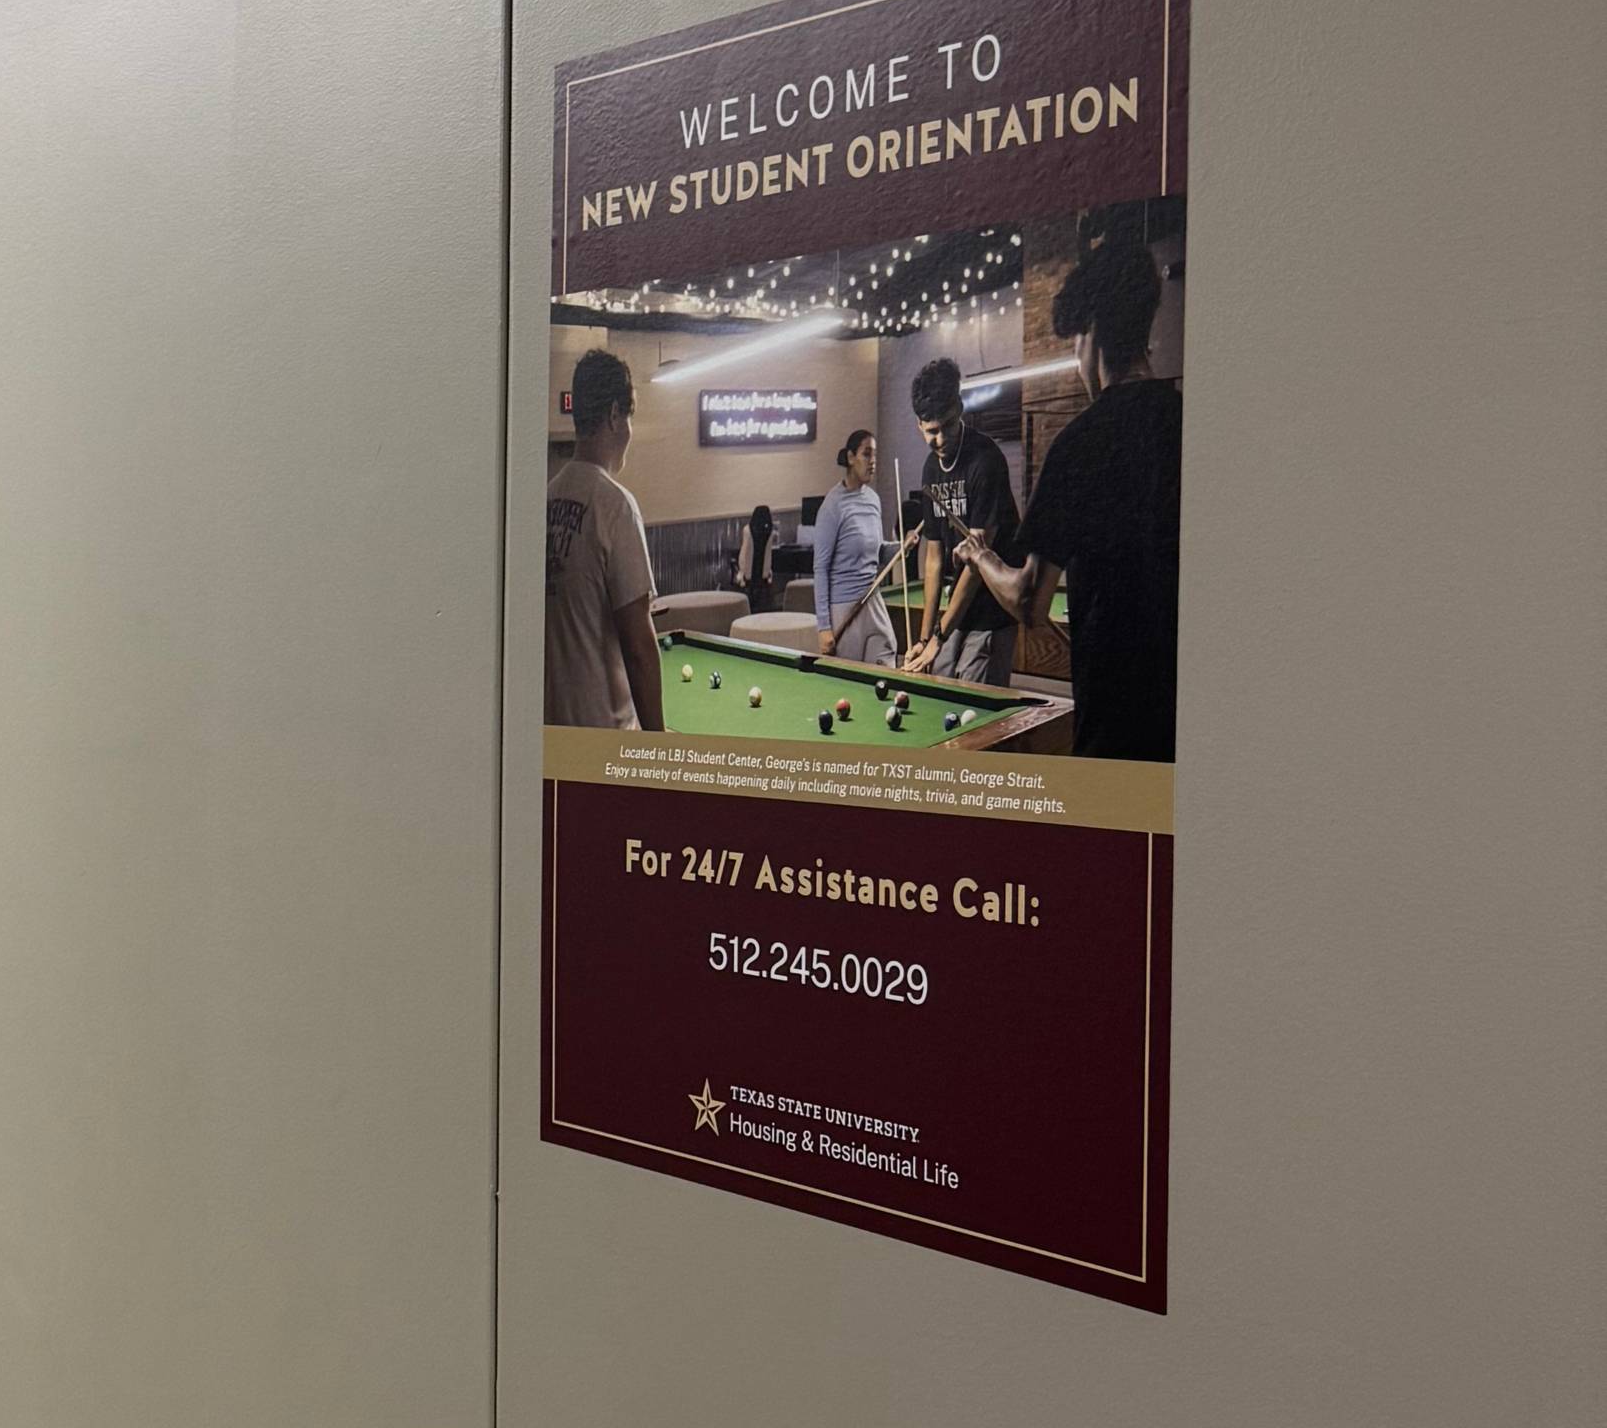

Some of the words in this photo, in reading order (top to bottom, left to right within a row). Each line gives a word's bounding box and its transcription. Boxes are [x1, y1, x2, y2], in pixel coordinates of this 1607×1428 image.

[680, 55, 910, 149] WELCOME
[938, 34, 1002, 90] TO
[582, 180, 659, 232] NEW
[669, 143, 834, 214] STUDENT
[846, 77, 1139, 179] ORIENTATION
[605, 762, 630, 779] Enjoy
[631, 767, 637, 777] a
[638, 765, 670, 782] variety
[671, 768, 682, 781] of
[683, 771, 715, 784] events
[716, 771, 768, 791] happening
[771, 775, 796, 793] daily
[797, 777, 847, 798] including
[849, 784, 882, 798] movie
[884, 785, 923, 803] nights,
[925, 789, 958, 806] trivia,
[961, 791, 984, 807] and
[986, 796, 1021, 811] game
[1023, 796, 1066, 814] nights.
[620, 745, 656, 761] Located
[657, 748, 667, 761] in
[668, 748, 685, 763] LBJ
[687, 749, 726, 766] Student
[727, 753, 763, 770] Center,
[765, 755, 810, 773] George's
[812, 759, 821, 772] is
[823, 761, 860, 776] named
[863, 762, 879, 777] for
[881, 763, 913, 780] TXST
[914, 766, 957, 784] alumni,
[960, 769, 1004, 788] George
[1007, 772, 1046, 789] Strait.
[625, 838, 672, 878] For
[681, 846, 744, 887] 24/7
[754, 854, 939, 913] Assistance
[952, 877, 1040, 927] Call:
[708, 932, 929, 1005] 512.245.0029
[730, 1085, 775, 1109] TEXAS
[777, 1096, 822, 1120] STATE
[824, 1107, 920, 1143] UNIVERSITY
[730, 1112, 797, 1152] Housing
[801, 1130, 814, 1154] &
[819, 1134, 918, 1179] Residential
[923, 1159, 959, 1189] Life
